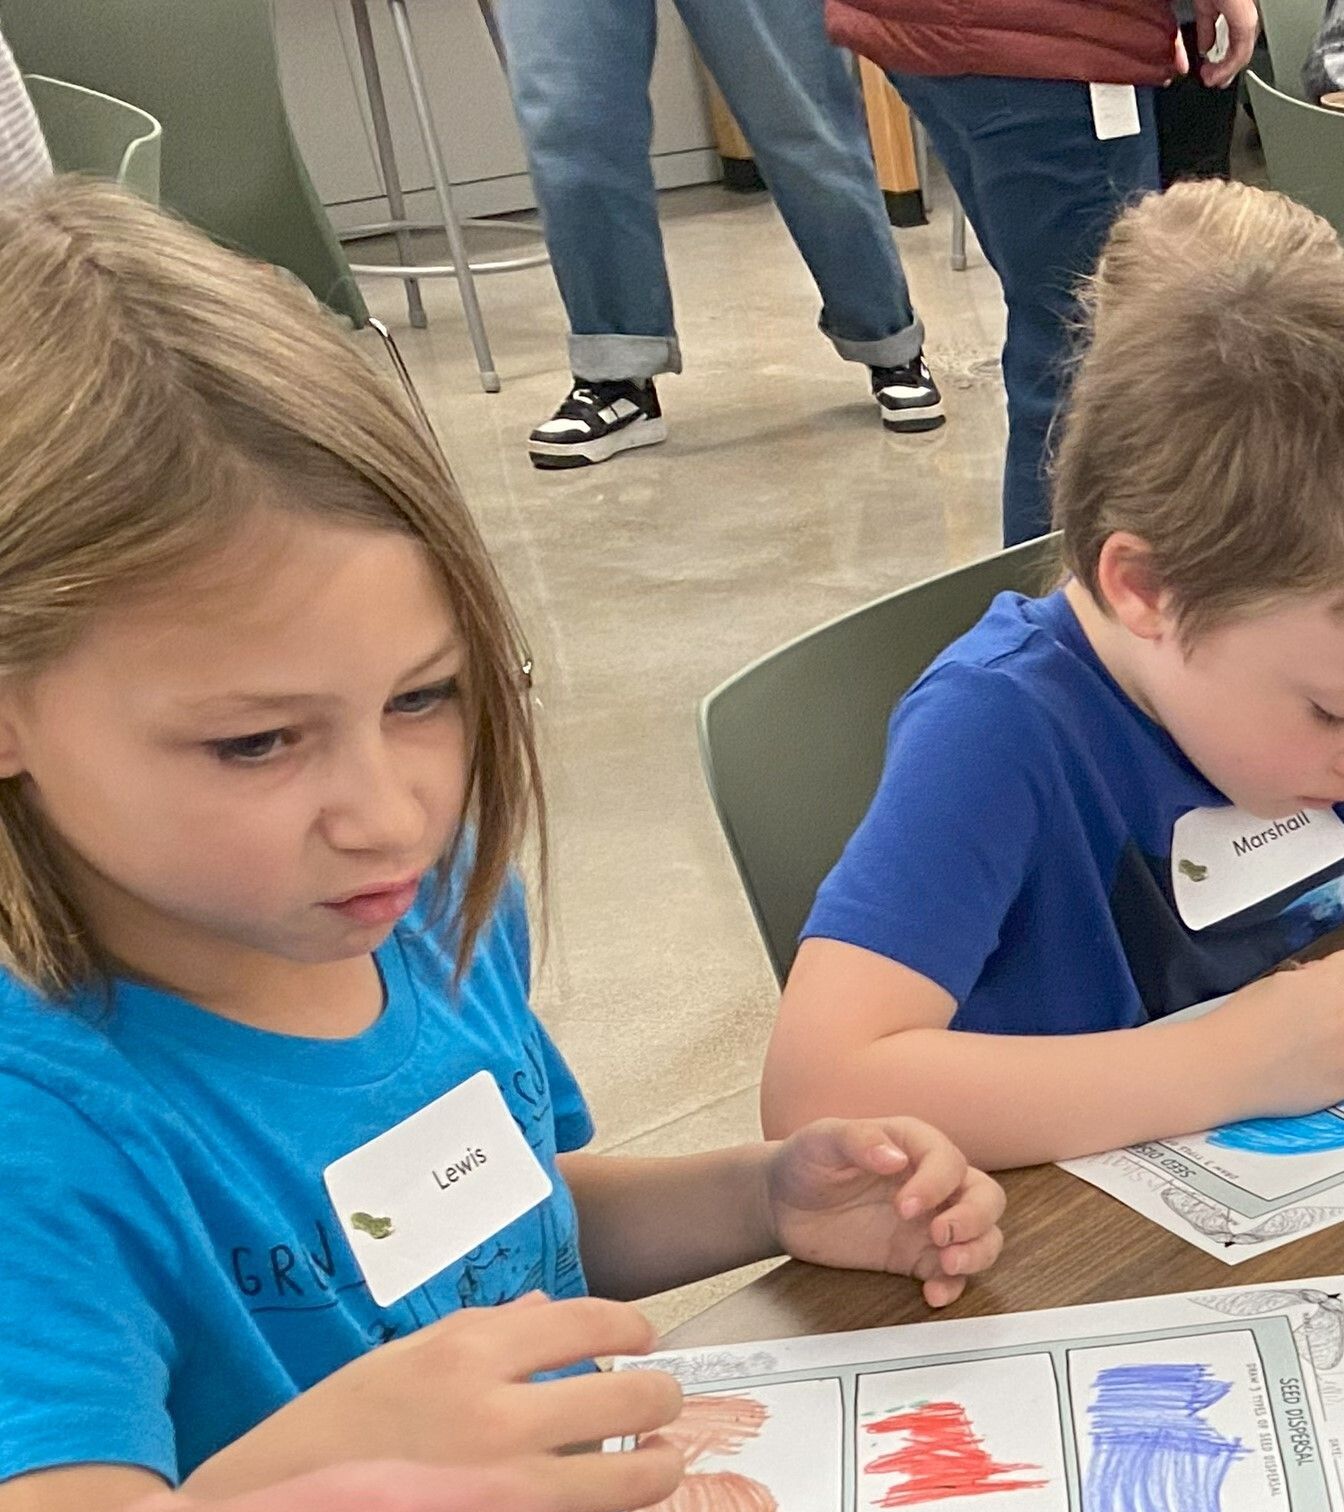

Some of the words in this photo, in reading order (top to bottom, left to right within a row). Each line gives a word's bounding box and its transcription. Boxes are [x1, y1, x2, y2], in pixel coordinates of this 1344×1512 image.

[1231, 811, 1311, 857] Marshall
[431, 1146, 488, 1191] Lewis
[1279, 1377, 1300, 1405] SEED
[1259, 1431, 1274, 1453] SEED
[1285, 1407, 1315, 1467] DISPERSAL
[1263, 1455, 1282, 1498] DISPERSAL
